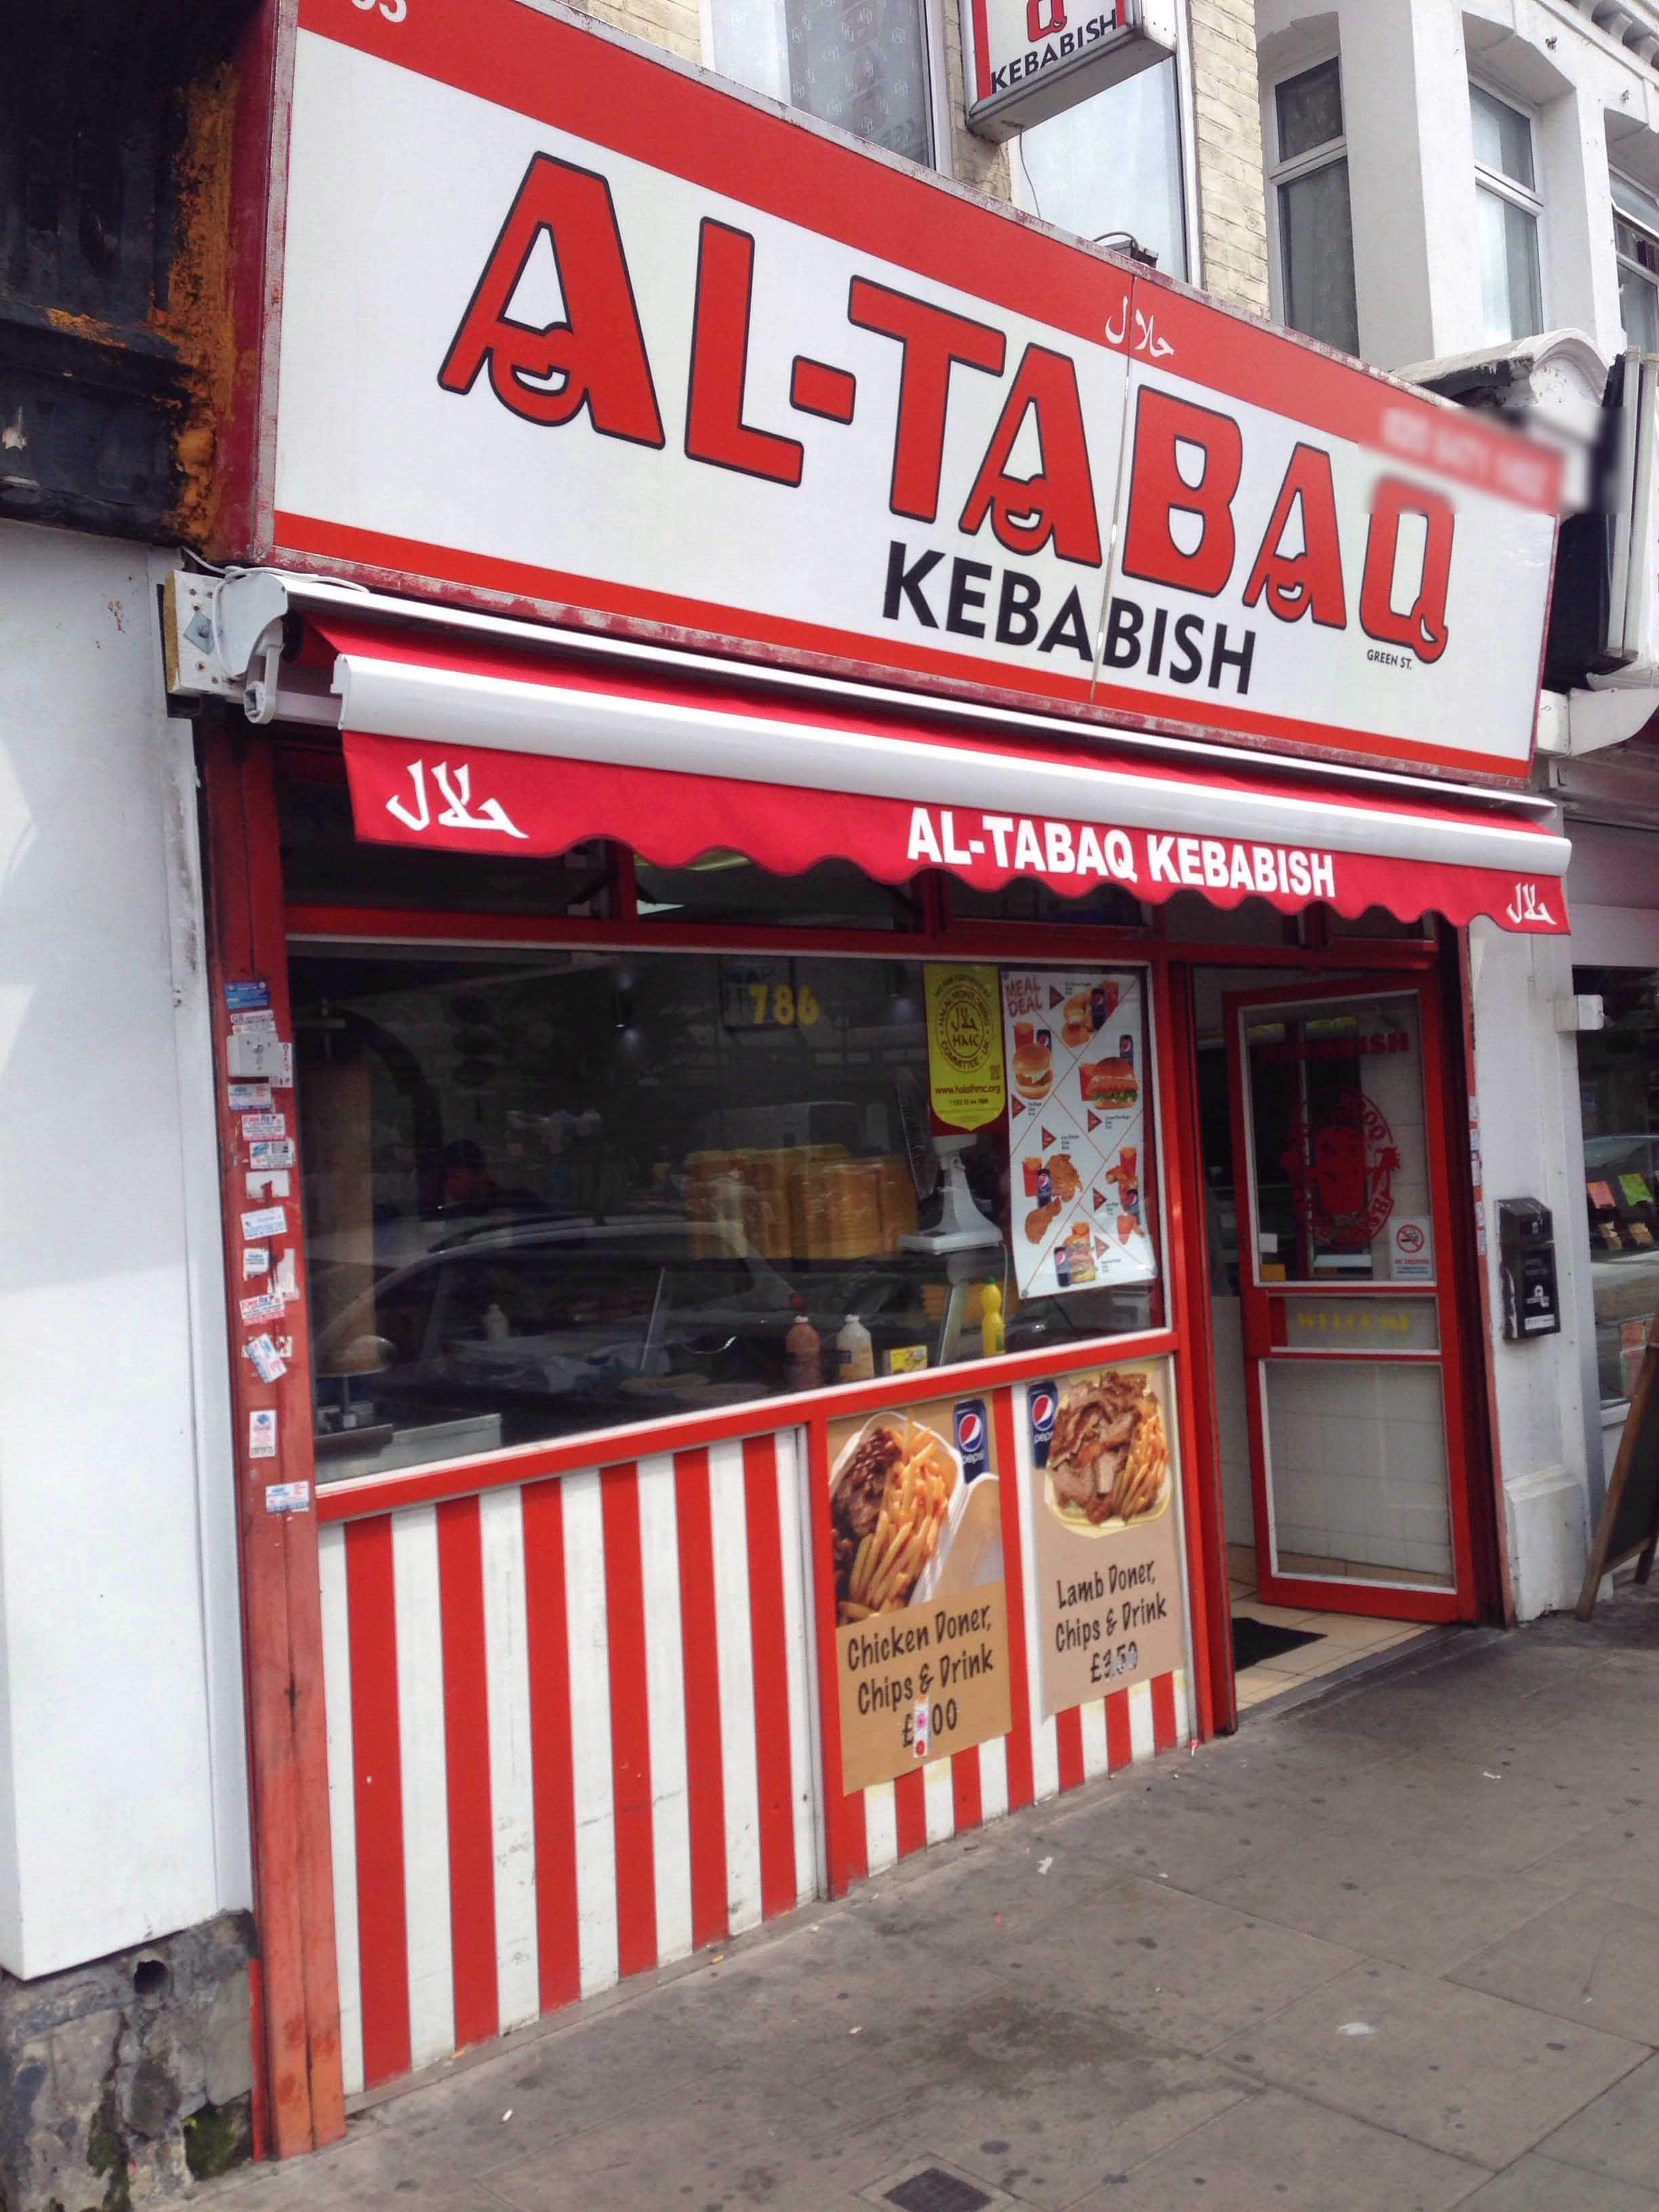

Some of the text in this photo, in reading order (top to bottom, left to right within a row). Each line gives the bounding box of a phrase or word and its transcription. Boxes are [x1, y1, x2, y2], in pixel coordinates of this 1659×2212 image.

[991, 9, 1117, 94] KEBABISH
[1105, 295, 1174, 358] حلال
[438, 150, 1456, 664] AL-TABAQ
[882, 541, 1256, 695] KEBABISH
[1366, 649, 1398, 666] GREEN
[386, 759, 529, 839] حلال
[907, 806, 1336, 898] AL-TABAQ KEBABISH
[1506, 882, 1557, 925] حلال
[748, 983, 821, 1025] 786
[952, 1033, 980, 1048] HMC
[1056, 1560, 1156, 1610] Lamb Doner,
[847, 1604, 992, 1673] Chicken Doner,
[1054, 1591, 1168, 1654] Chips & Drink
[857, 1642, 994, 1717] Chips & Drink
